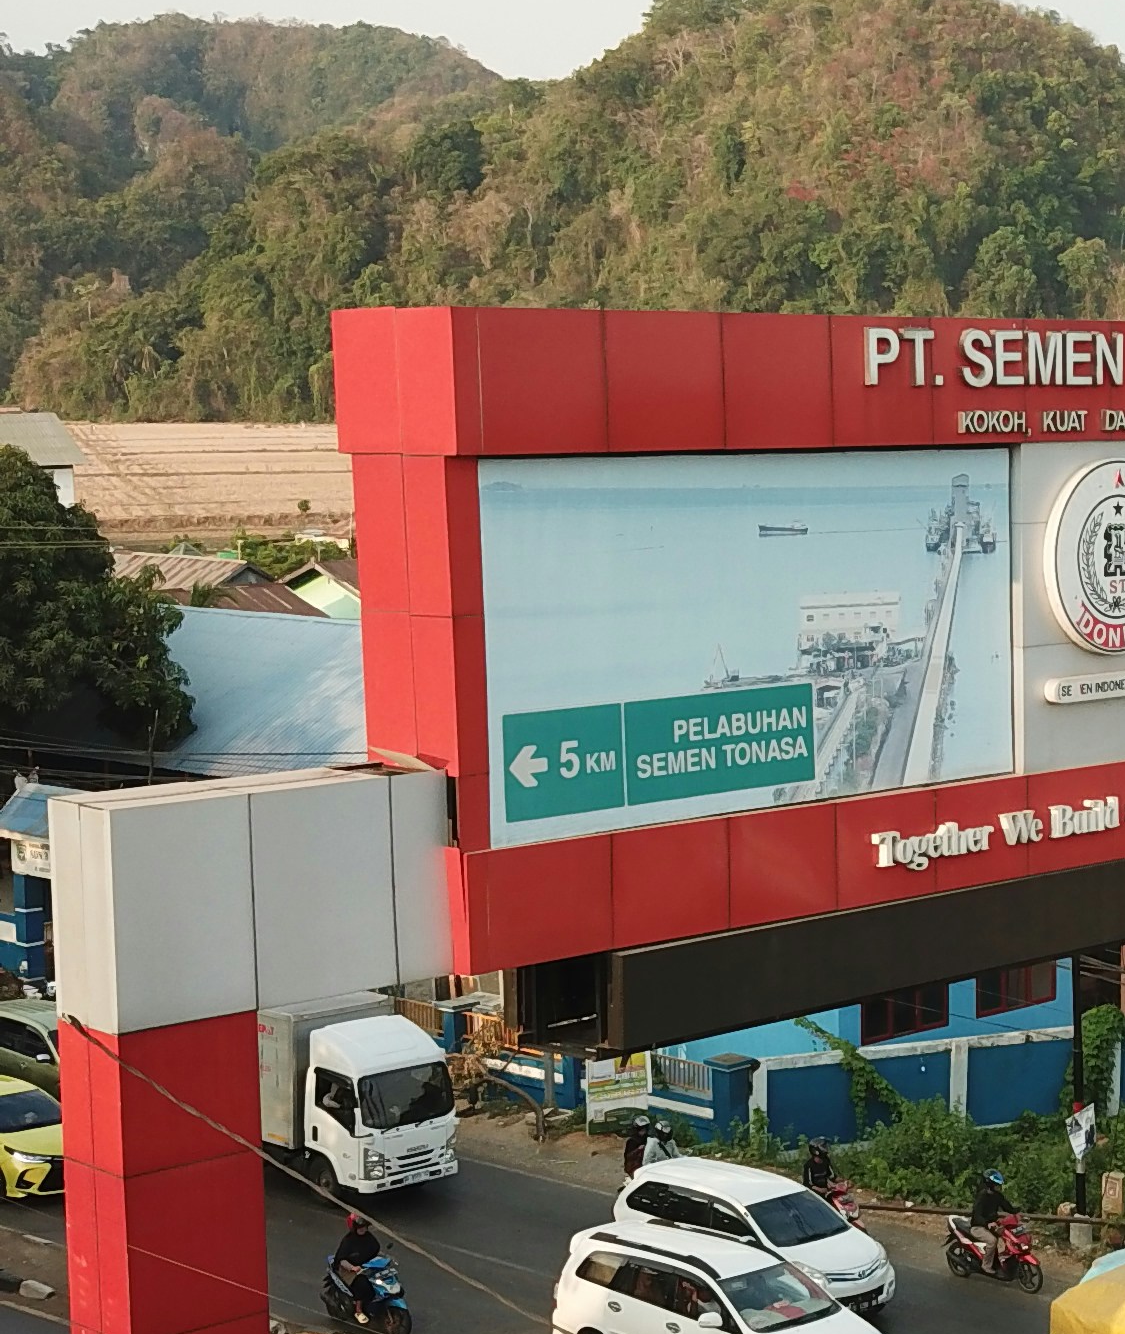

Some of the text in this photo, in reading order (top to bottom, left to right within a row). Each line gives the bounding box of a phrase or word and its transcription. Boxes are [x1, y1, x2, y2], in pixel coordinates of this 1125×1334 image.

[864, 326, 944, 386] PT.
[960, 326, 1124, 388] SEMEN
[957, 409, 1032, 437] KOKOH,
[1042, 409, 1088, 432] KUAT
[673, 706, 807, 743] PELABUHAN
[559, 740, 616, 778] 5 KM
[636, 735, 808, 779] SEMEN TONASA
[871, 821, 995, 870] Together
[998, 809, 1043, 845] We
[1048, 796, 1120, 839] Build
